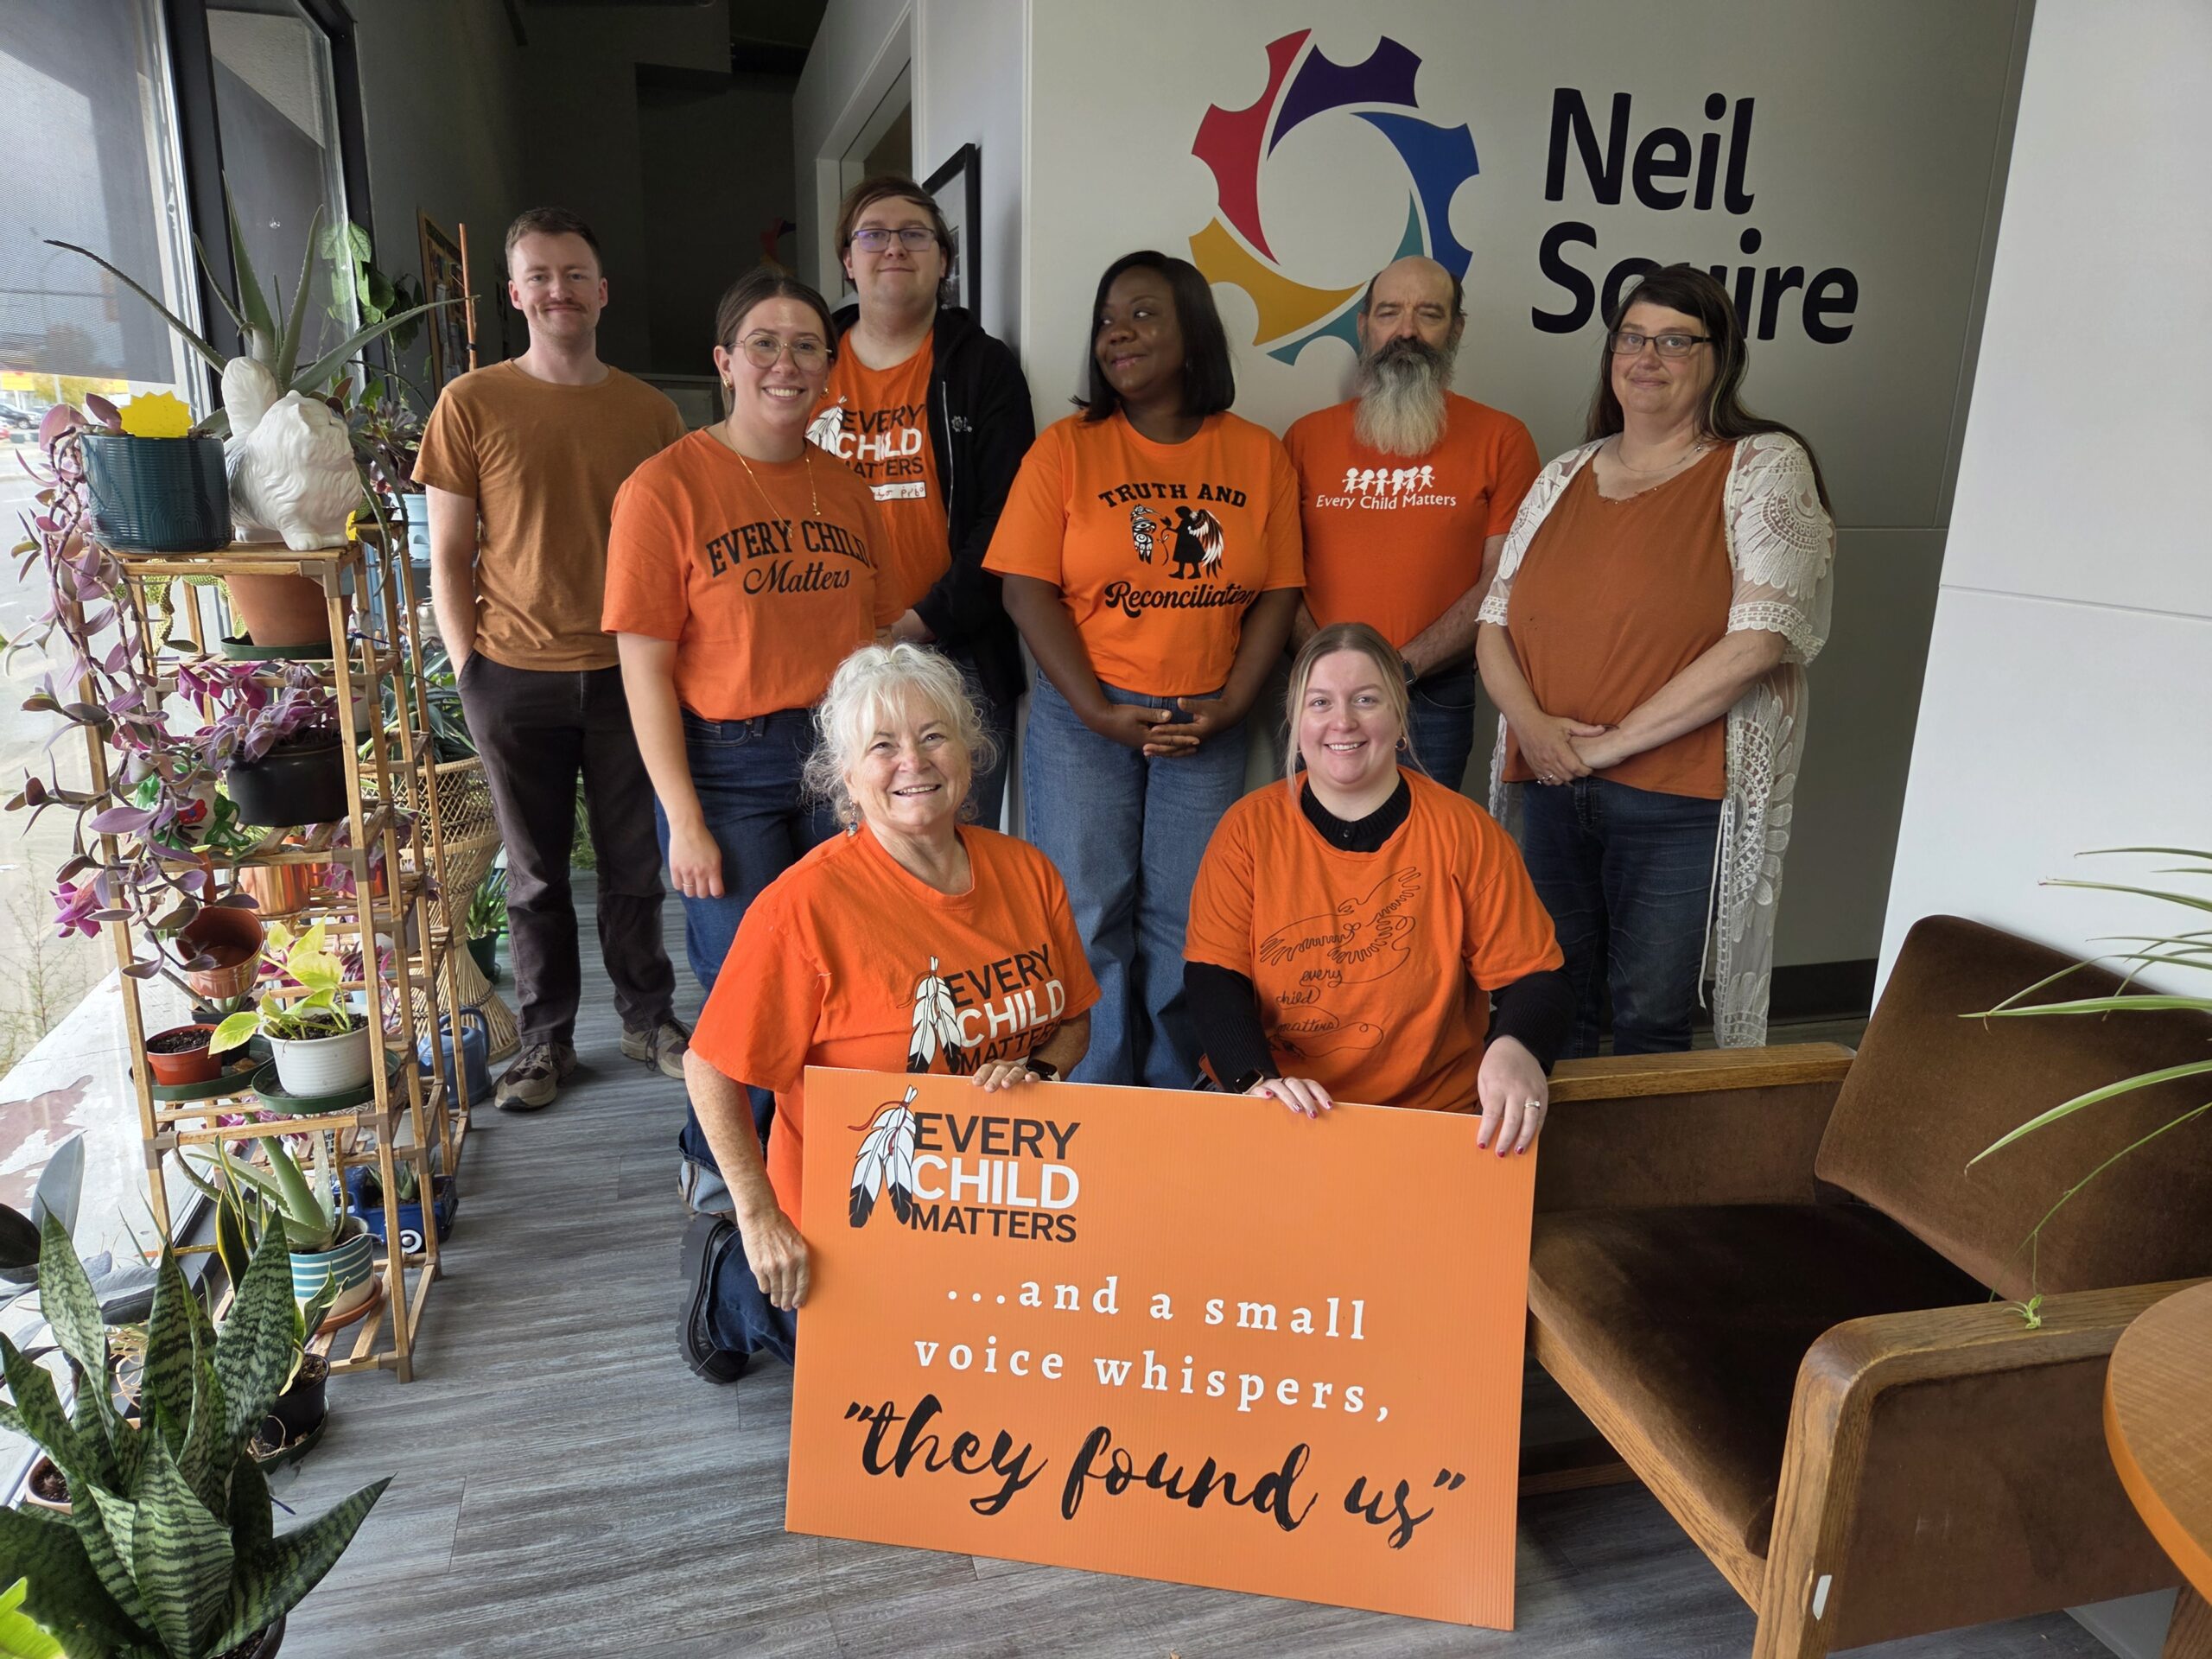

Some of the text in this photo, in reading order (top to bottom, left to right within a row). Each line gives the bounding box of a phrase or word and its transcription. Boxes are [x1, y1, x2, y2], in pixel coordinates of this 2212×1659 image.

[1545, 88, 1755, 214] Neil
[1532, 221, 1859, 344] Sire
[842, 404, 925, 433] EVERY
[836, 428, 922, 461] CHILD
[846, 456, 924, 479] ATTERS
[1098, 483, 1248, 508] TRUTH AND
[1316, 493, 1458, 510] Every Child Matters
[706, 519, 870, 578] EVERY CHILD
[743, 559, 851, 595] Matters
[1104, 581, 1256, 619] Reconciliation
[943, 944, 1054, 1008] EVERY
[1300, 969, 1343, 988] every
[957, 979, 1065, 1048] CHILD
[1276, 989, 1318, 1005] child
[1278, 1019, 1336, 1033] matters
[914, 1111, 1081, 1160] EVERY
[912, 1154, 1079, 1210] CHILD
[911, 1203, 1077, 1243] MATTERS
[948, 1275, 1364, 1340] ...and a small
[914, 1335, 1389, 1422] voice whispers,
[1061, 1426, 1319, 1532] found
